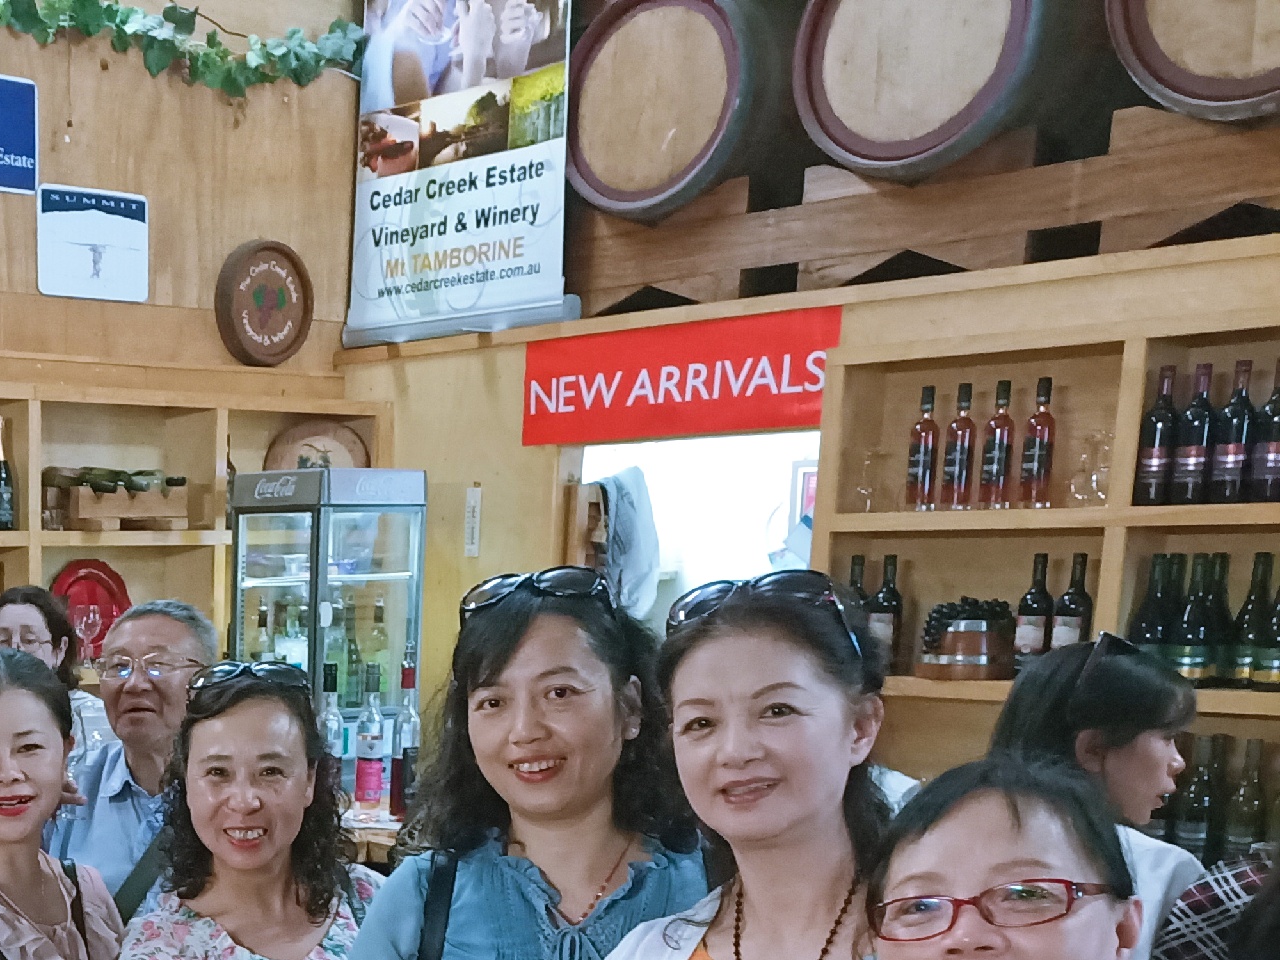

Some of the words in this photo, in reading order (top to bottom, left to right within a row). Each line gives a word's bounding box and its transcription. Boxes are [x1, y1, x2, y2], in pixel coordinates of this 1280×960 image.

[50, 192, 139, 210] SUMMIT
[370, 186, 421, 211] Cedar
[425, 171, 479, 200] Creek
[485, 159, 545, 188] Estate
[371, 215, 448, 247] Vineyard
[454, 211, 468, 233] &
[475, 202, 540, 228] Winery
[385, 257, 407, 279] Mt
[412, 236, 525, 275] TAMBORINE
[377, 261, 542, 299] www.cedarcreekestate.com.au
[530, 371, 623, 415] NEW
[626, 350, 827, 407] ARRIVALS
